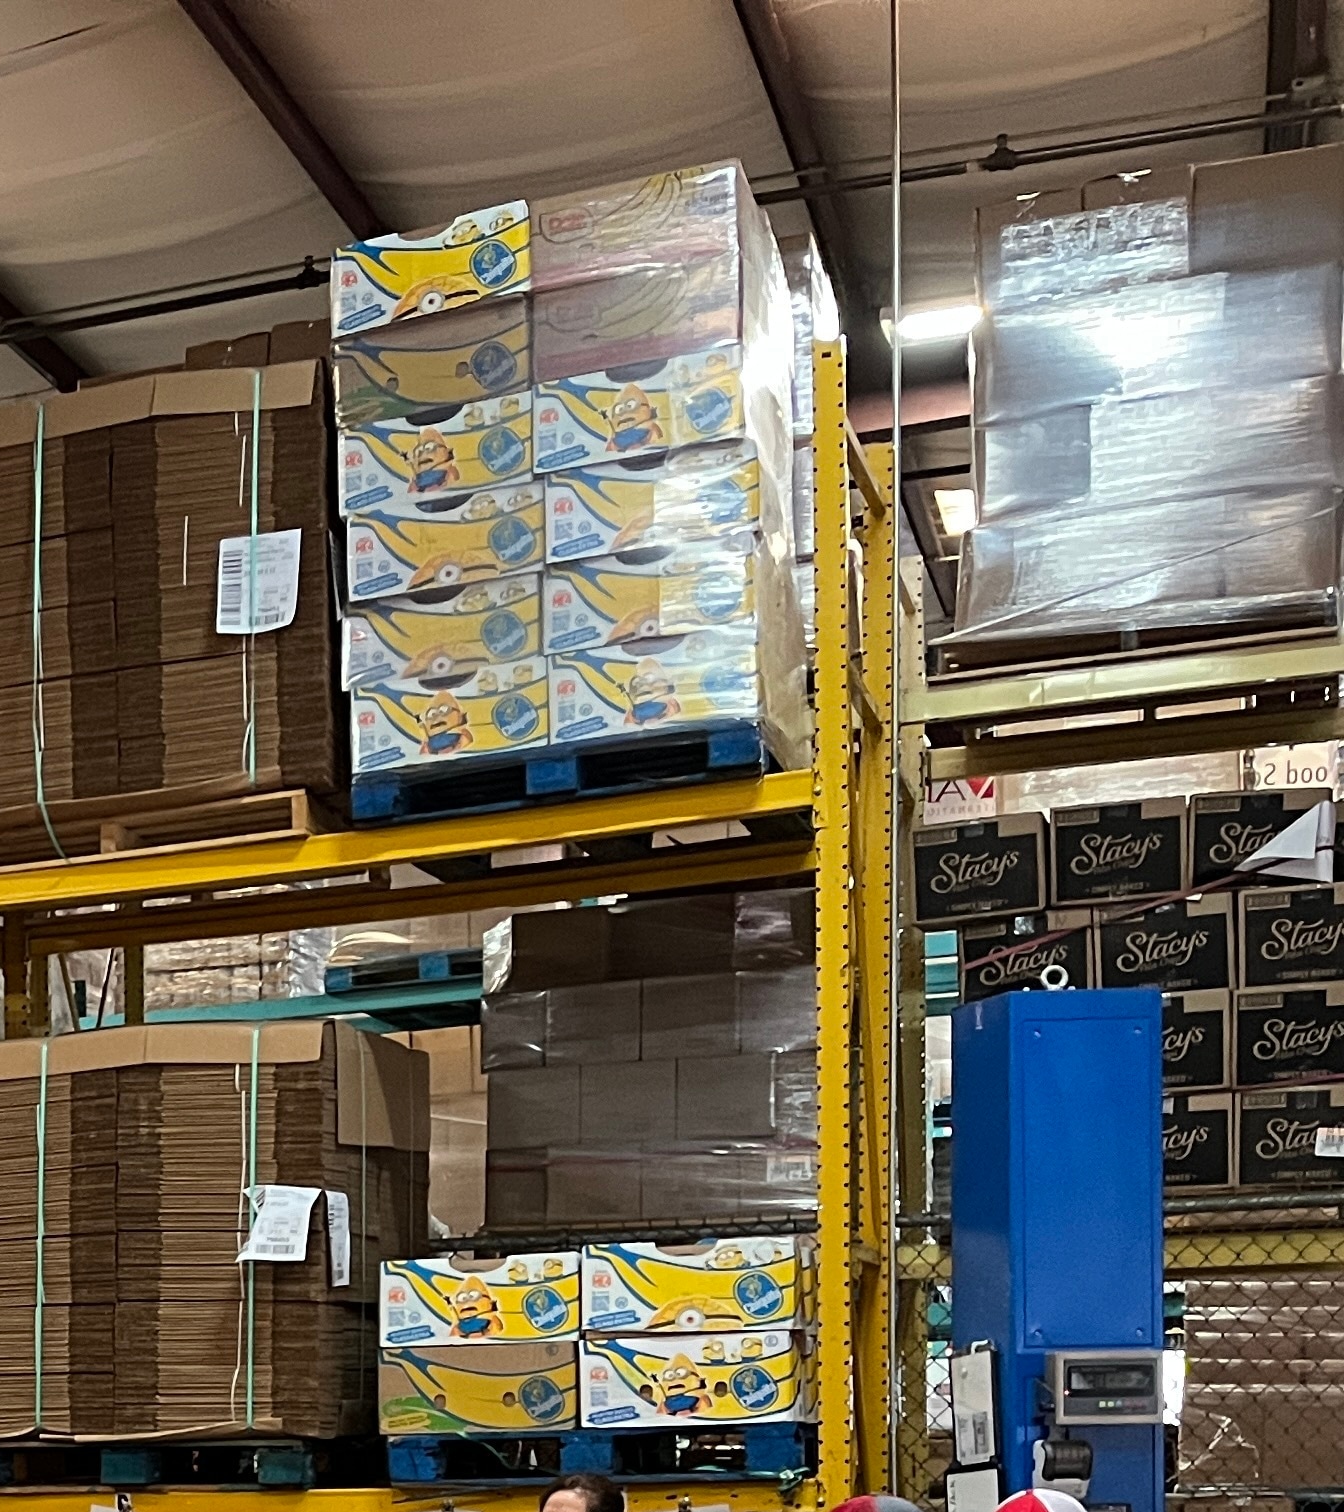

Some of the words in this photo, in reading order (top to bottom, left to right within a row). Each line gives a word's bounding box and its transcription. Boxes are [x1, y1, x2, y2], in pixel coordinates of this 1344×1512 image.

[931, 849, 1019, 893] Stacy's
[1071, 833, 1162, 875] Stacy's
[1117, 930, 1209, 973] Stacy's
